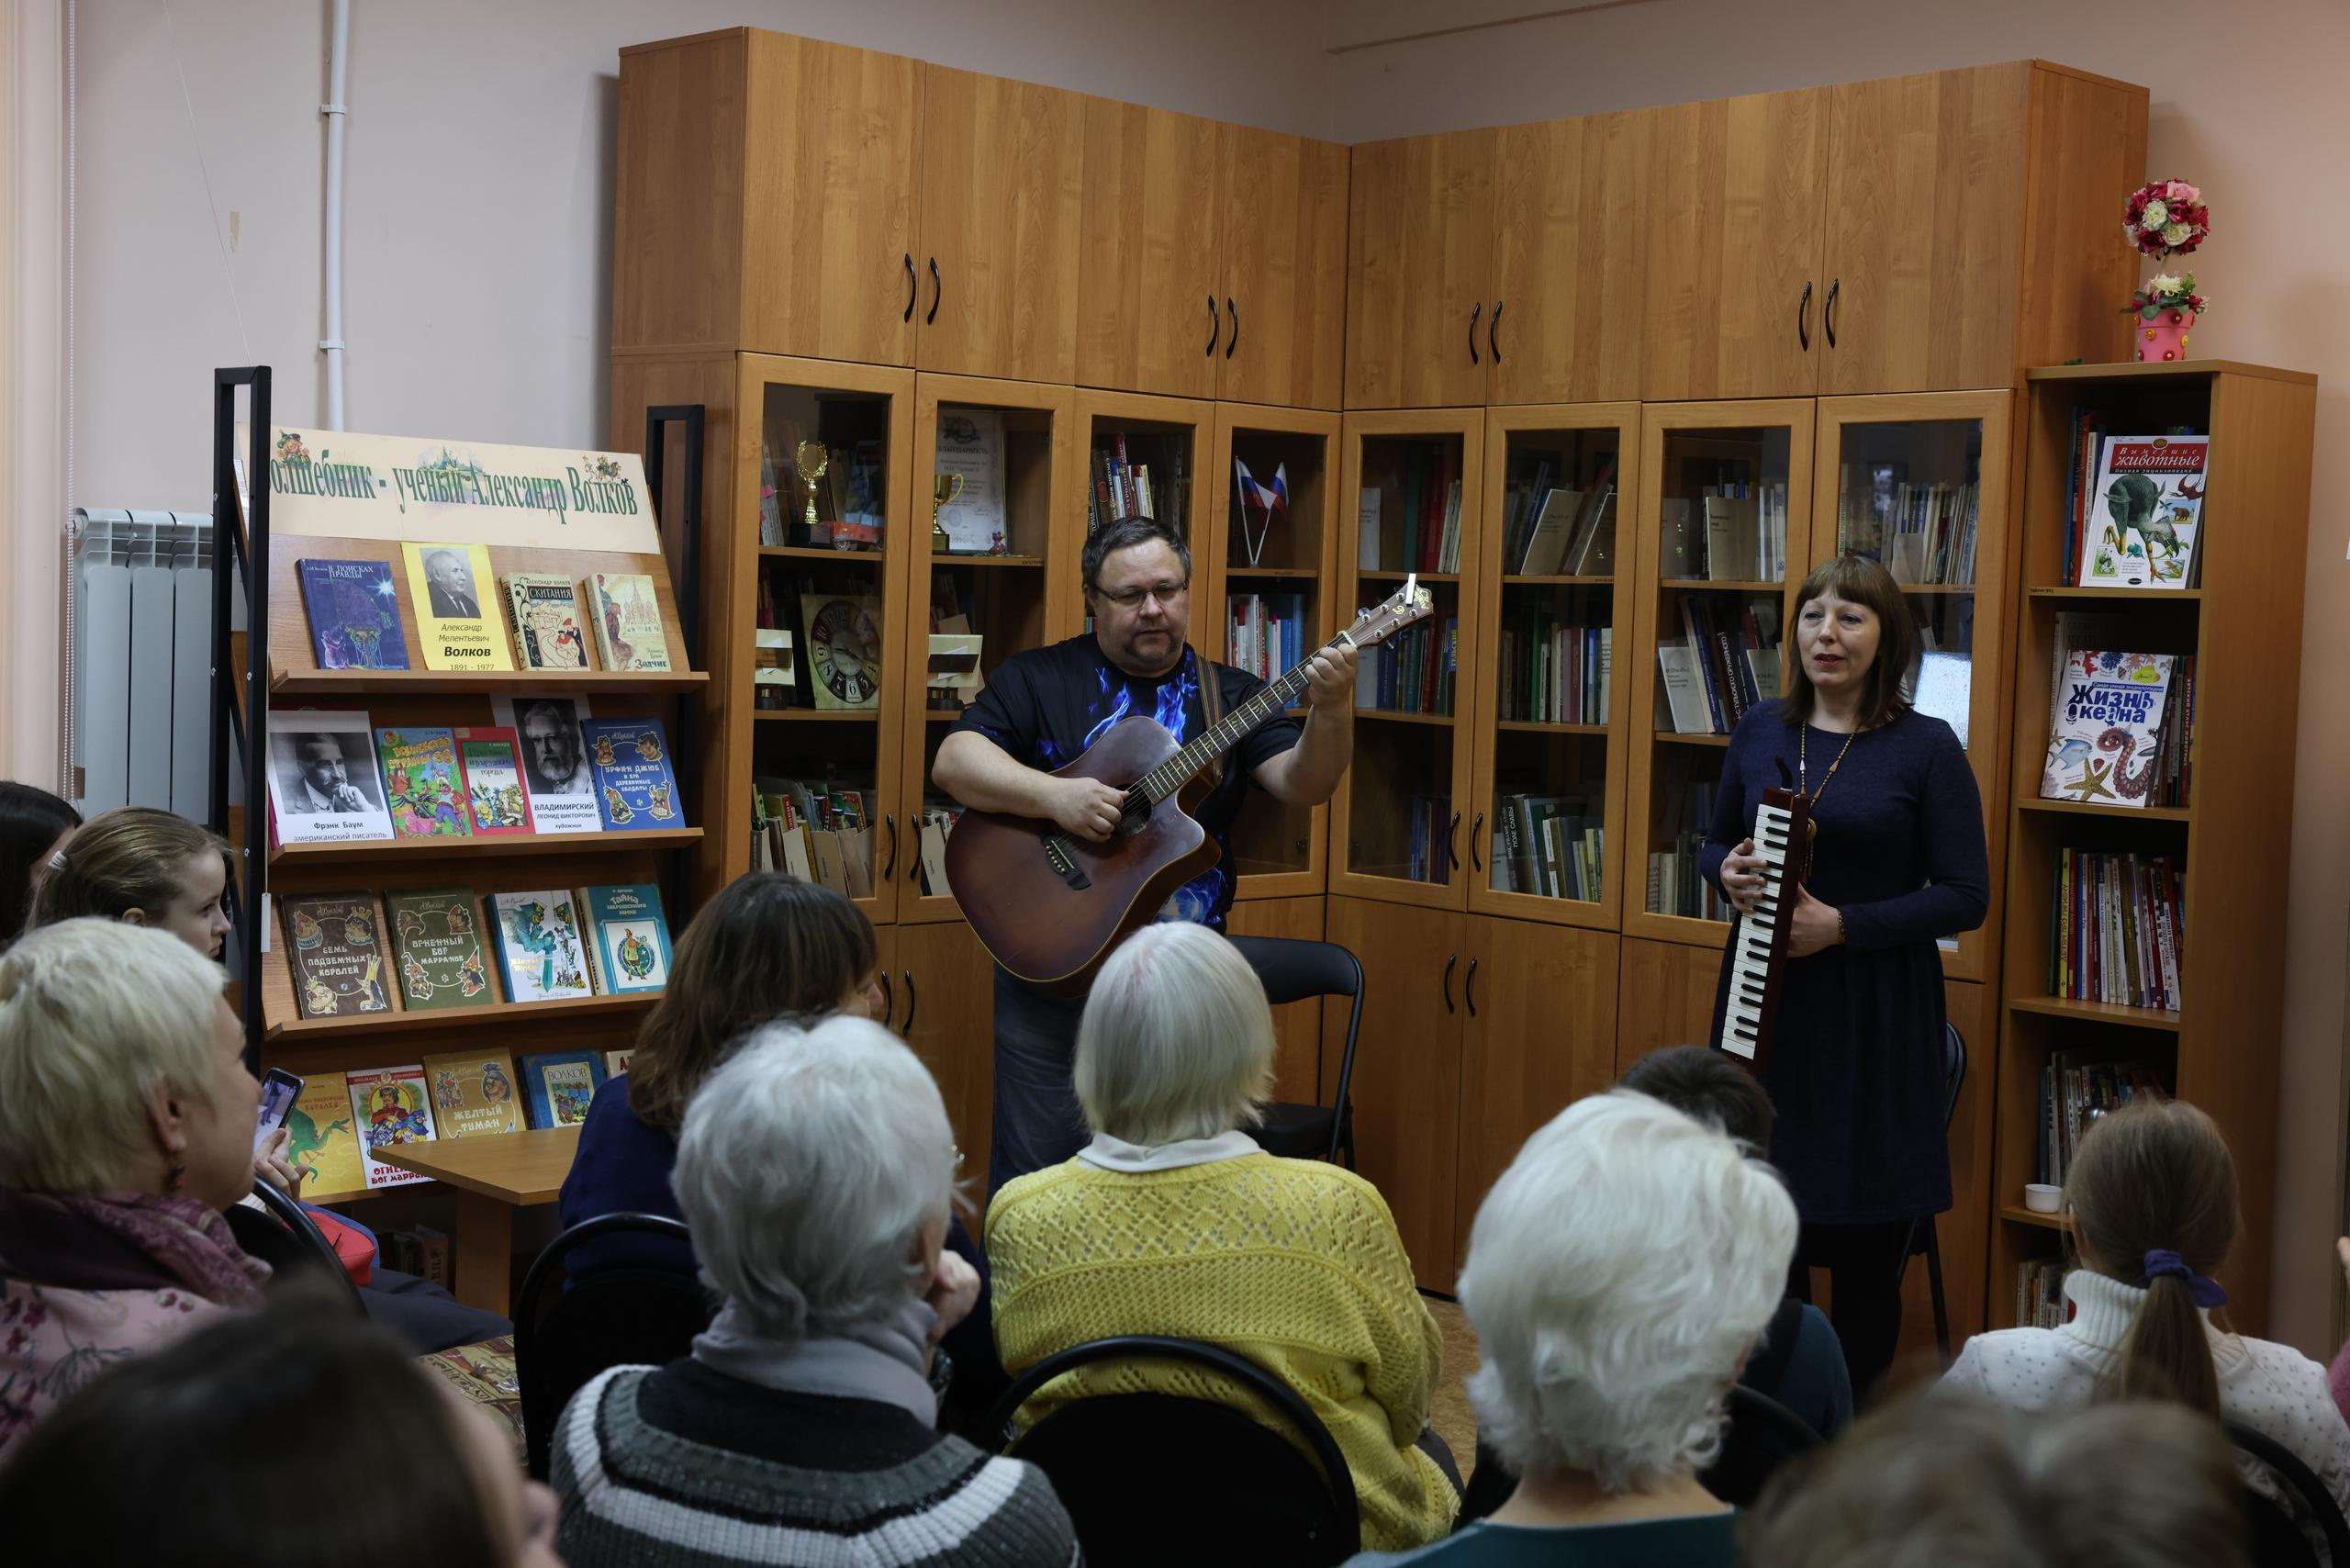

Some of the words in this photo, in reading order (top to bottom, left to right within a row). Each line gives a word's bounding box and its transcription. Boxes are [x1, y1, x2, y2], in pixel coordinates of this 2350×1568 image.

[2115, 454, 2200, 466] животные
[270, 449, 376, 498] олшебник
[469, 459, 567, 524] Александр
[565, 465, 637, 515] Волков
[330, 571, 363, 579] ПРАВДЫ
[337, 565, 374, 573] ПОИСКАХ
[529, 588, 572, 599] СКИТАНИЯ
[441, 623, 483, 633] Александр
[438, 633, 490, 643] Мелентьевич
[443, 646, 492, 657] Волков
[835, 676, 844, 690] 7
[849, 682, 856, 696] 6
[2067, 684, 2156, 709] Жизнь
[432, 748, 455, 765] ОЗ
[605, 765, 632, 773] УРФИН
[534, 801, 594, 812] ВЛАДИМИРСКИЙ
[1507, 806, 1516, 829] СЛАВЫ
[313, 822, 340, 830] Фрэнк
[343, 821, 364, 830] Баум
[293, 833, 351, 843] американский
[352, 832, 387, 840] писатель
[1510, 829, 1519, 848] ПОЛЕ
[411, 936, 464, 948] ОГНЕННЫЙ
[322, 946, 347, 954] СЕМЬ
[431, 947, 449, 956] БОГ
[308, 955, 367, 967] ПОДЗЕМНЫХ
[420, 955, 464, 965] МАРРАНОВ
[319, 964, 360, 977] КОРОЛЕЙ
[547, 1068, 588, 1081] ВОЛКОВ
[453, 1103, 503, 1120] ЖЕЛТЫЙ
[461, 1118, 500, 1132] ТУМАН
